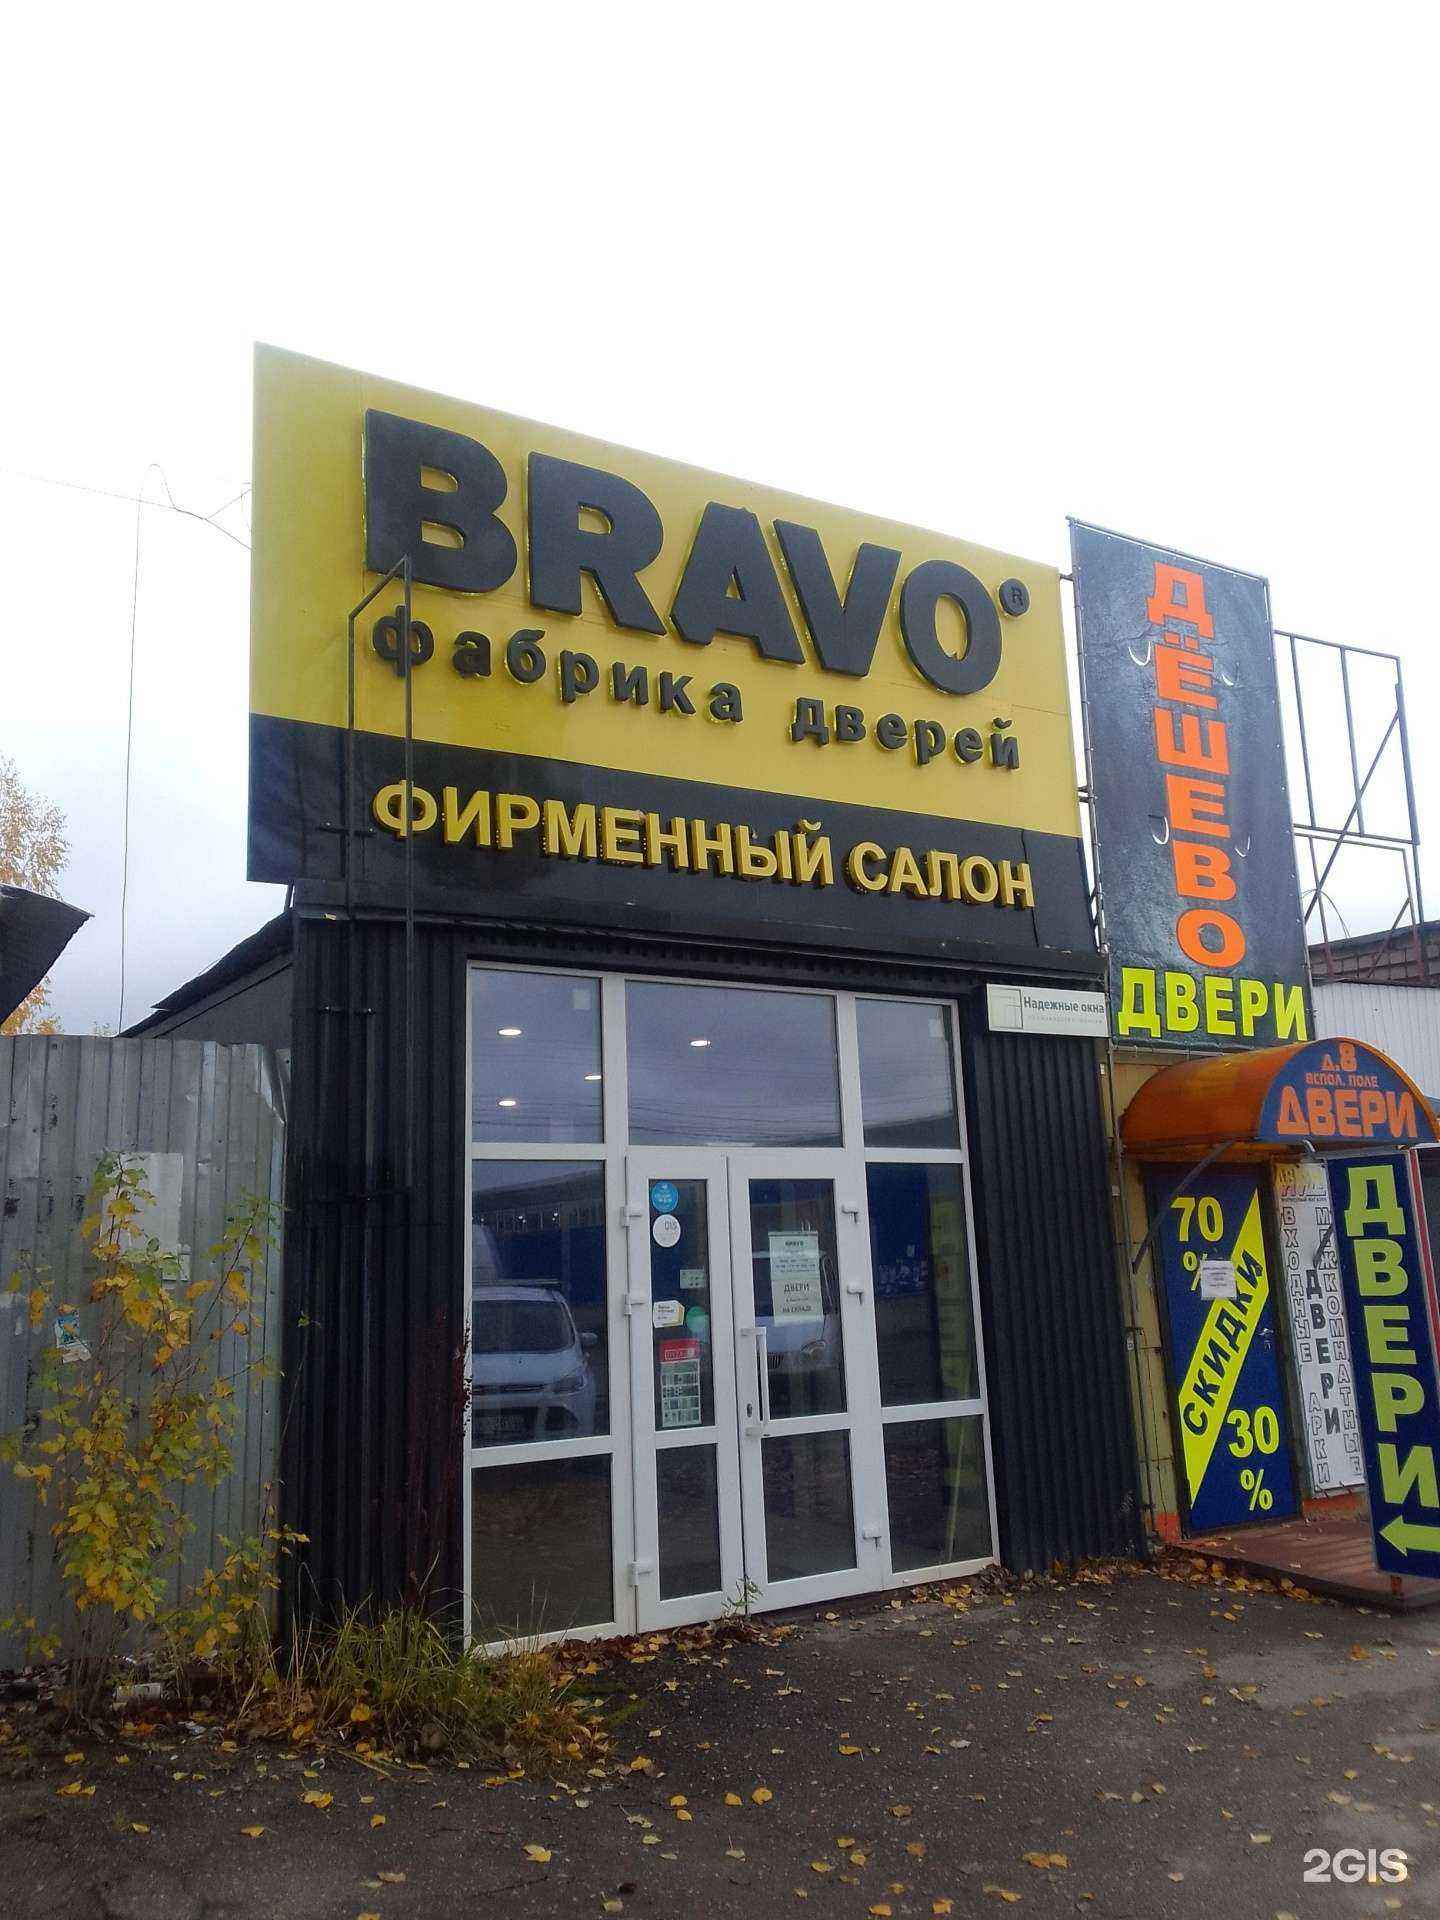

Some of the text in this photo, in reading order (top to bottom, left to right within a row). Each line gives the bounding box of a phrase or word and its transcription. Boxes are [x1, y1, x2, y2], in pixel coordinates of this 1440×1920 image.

[364, 408, 1003, 696] BRAVO
[371, 605, 1020, 771] фабрика дверей
[1146, 561, 1246, 968] ДЁШЕВО
[372, 780, 1035, 909] ФИРМЕННЫЙ САЛОН
[1023, 996, 1105, 1014] Надежные окна
[1117, 967, 1308, 1042] ДВЕРИ
[1277, 1086, 1418, 1139] ДВЕРИ
[1170, 1196, 1224, 1242] 70
[1182, 1249, 1264, 1436] СКИДКИ
[1305, 1269, 1341, 1436] ДВЕРИ
[1344, 1164, 1440, 1508] ДВЕРИ
[1227, 1406, 1280, 1459] 30
[1240, 1468, 1274, 1511] %
